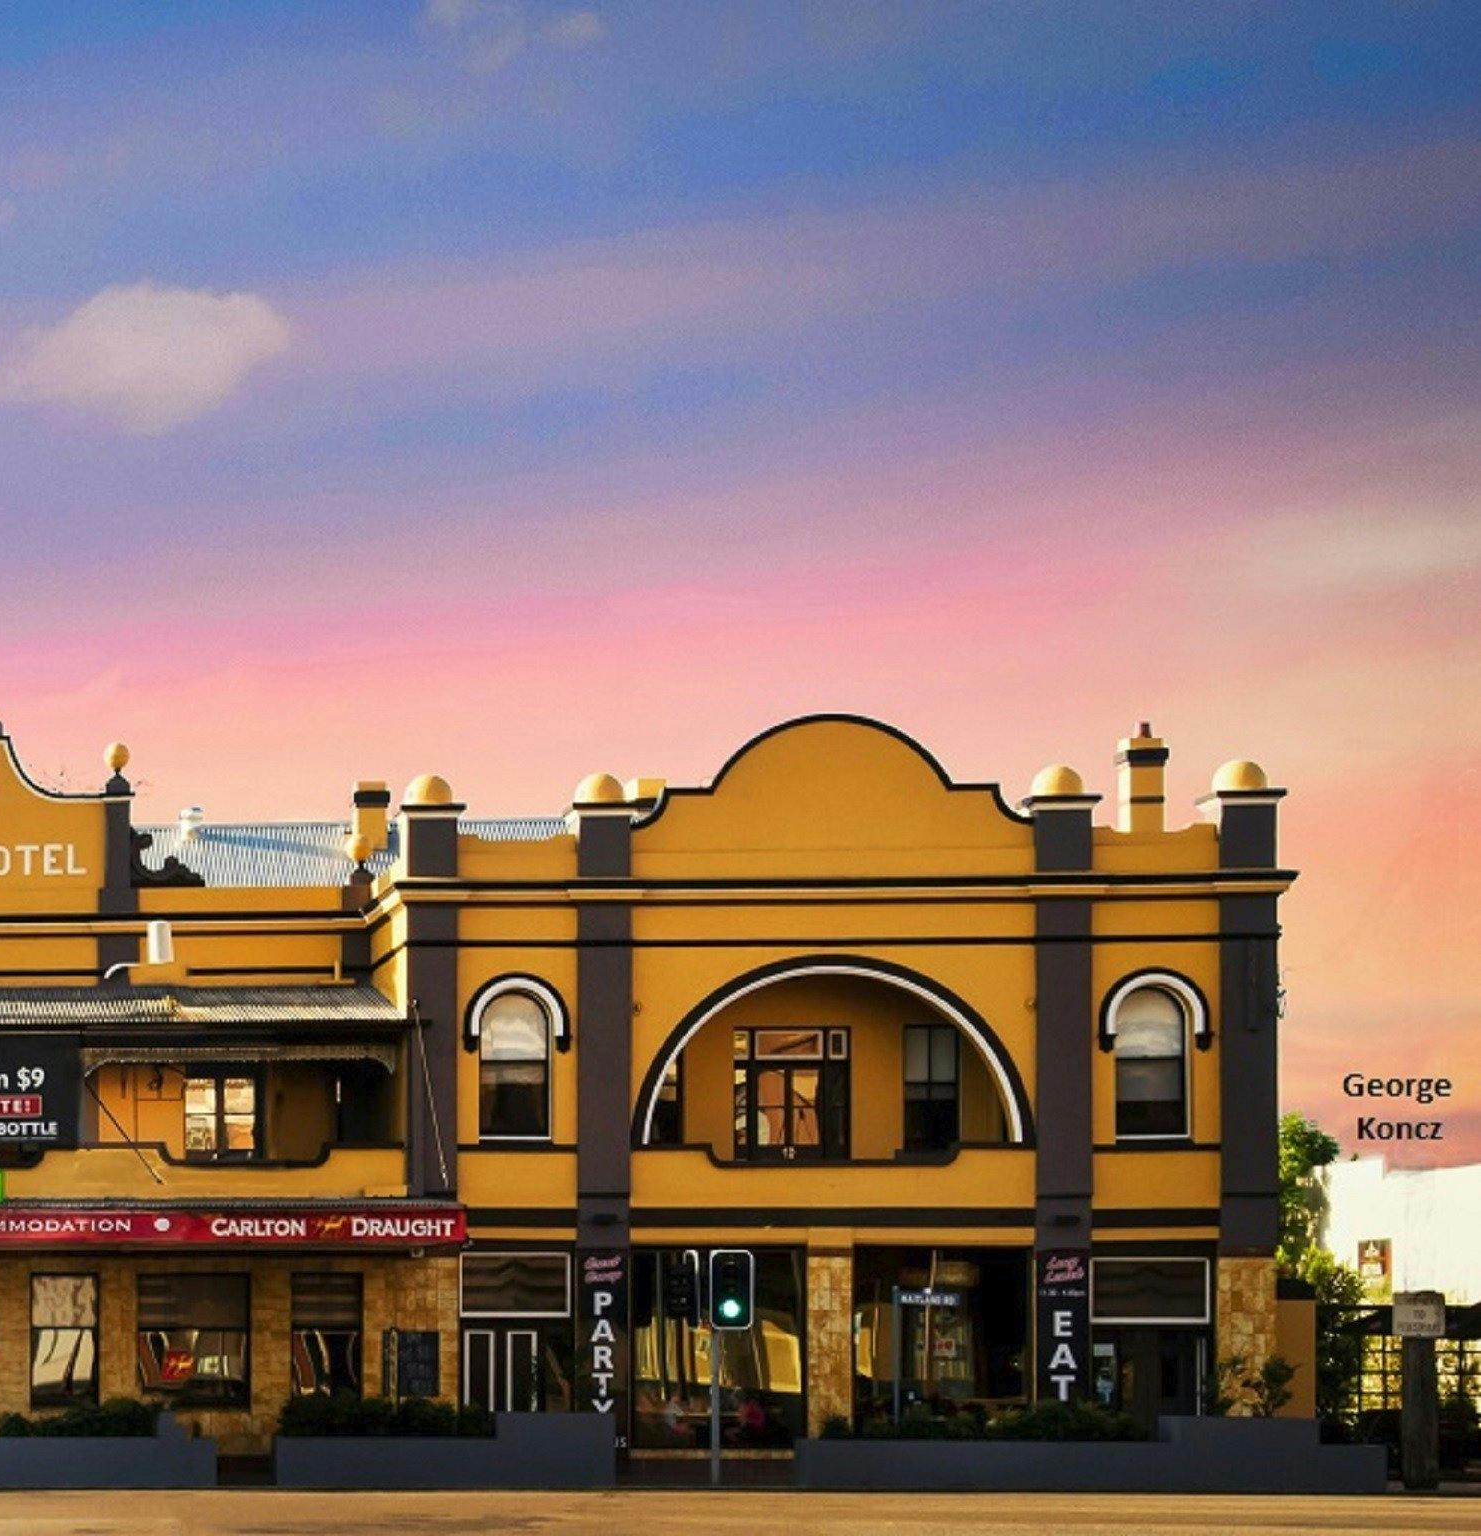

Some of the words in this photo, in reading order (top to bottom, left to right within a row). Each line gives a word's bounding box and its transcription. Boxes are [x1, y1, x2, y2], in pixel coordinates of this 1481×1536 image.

[17, 1066, 46, 1092] $9
[210, 1217, 307, 1238] CARLTON
[351, 1217, 456, 1238] DRAUGHT
[1047, 1310, 1078, 1402] EAT
